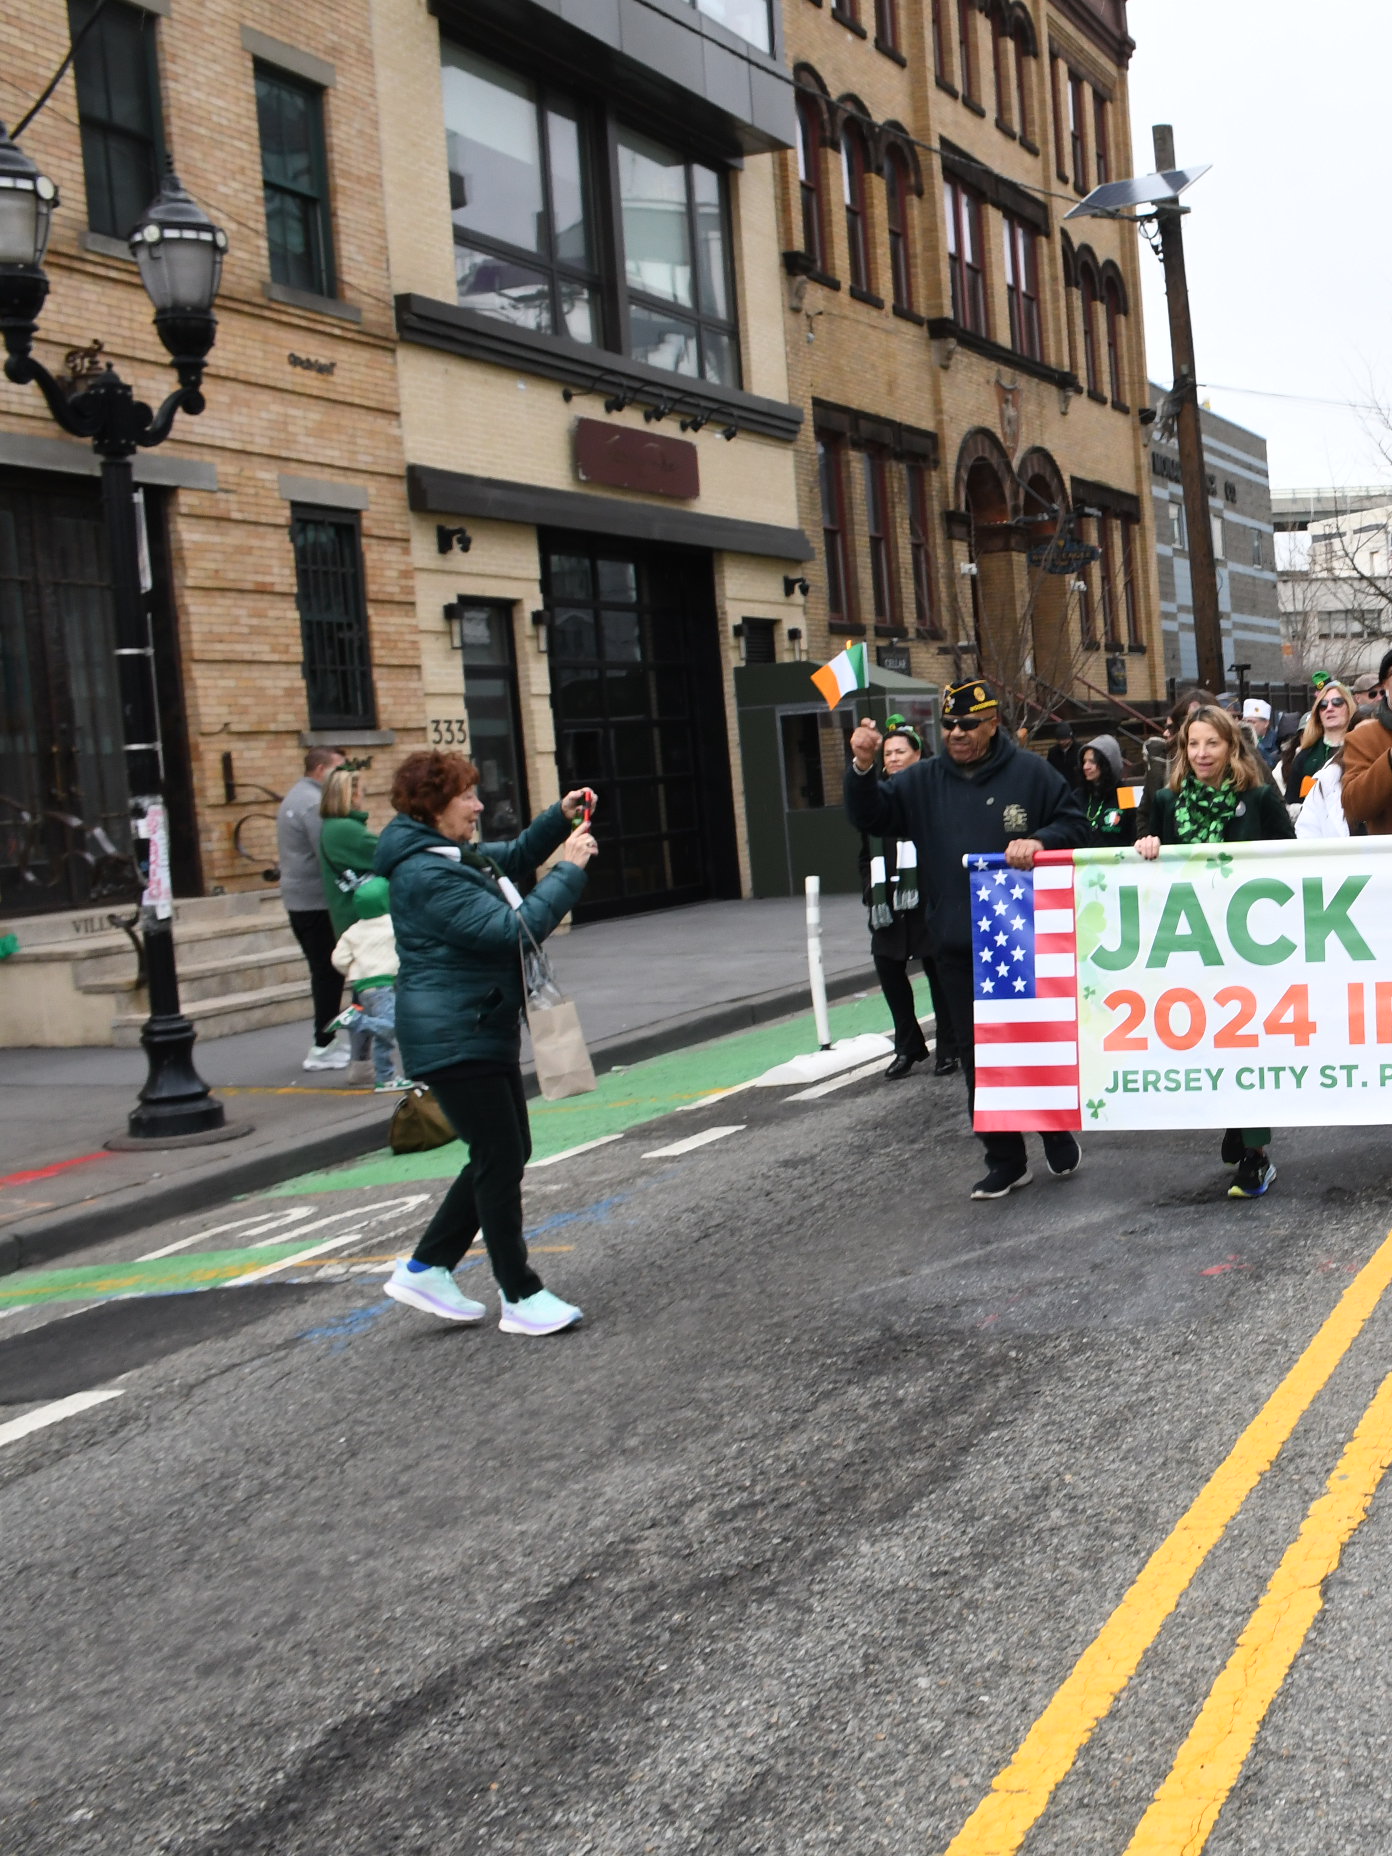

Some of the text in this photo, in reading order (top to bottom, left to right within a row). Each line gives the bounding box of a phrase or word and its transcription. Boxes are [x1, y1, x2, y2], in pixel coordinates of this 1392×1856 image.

[431, 719, 467, 745] 333
[1090, 875, 1377, 971] JACK
[1103, 984, 1317, 1051] 2024
[1104, 1067, 1224, 1094] JERSEY
[1235, 1066, 1309, 1090] CITY
[1319, 1064, 1368, 1089] ST.
